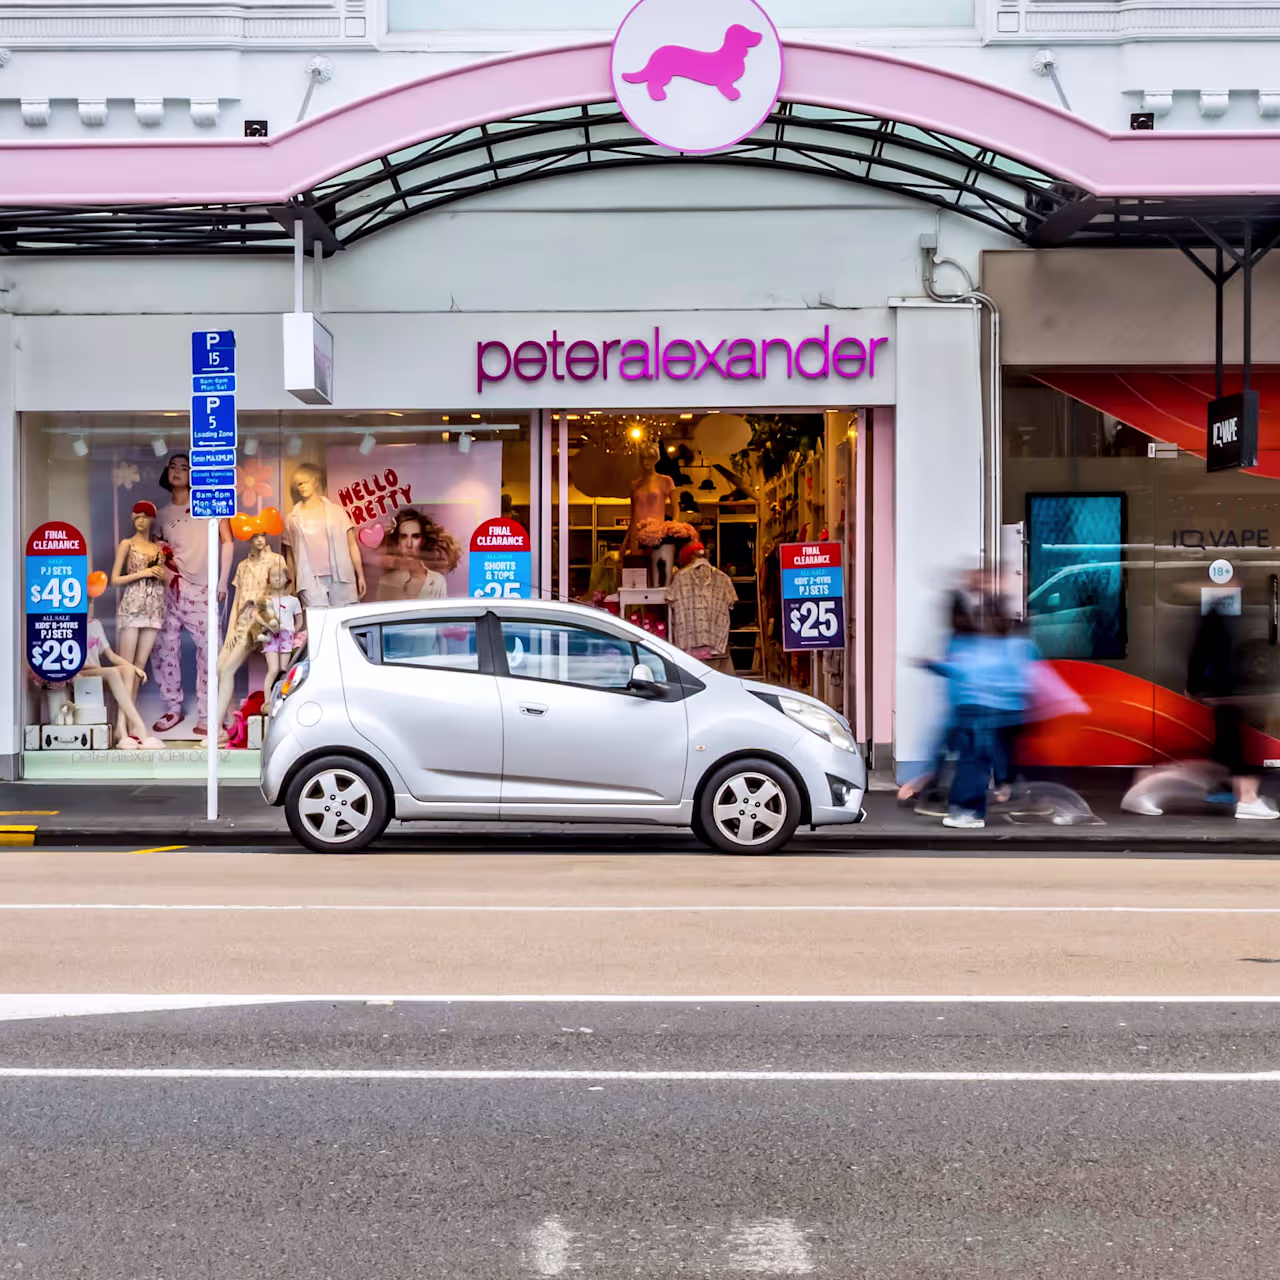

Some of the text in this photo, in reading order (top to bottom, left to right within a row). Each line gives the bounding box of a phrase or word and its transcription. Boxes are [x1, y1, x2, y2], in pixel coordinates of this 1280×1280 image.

[206, 332, 220, 350] P
[208, 352, 220, 365] 15
[477, 324, 888, 394] peteralexander
[206, 397, 220, 414] P
[208, 415, 217, 429] 5
[194, 431, 217, 439] Loading
[205, 453, 234, 462] MAXIMUM
[337, 468, 399, 508] HELLO
[45, 530, 68, 539] FINAL
[489, 526, 512, 535] FINAL
[33, 540, 80, 550] CLEARANCE
[477, 536, 524, 546] CLEARANCE
[802, 546, 820, 555] FINAL
[793, 555, 830, 565] CLEARANCE
[52, 566, 72, 575] SETS
[484, 561, 516, 570] SHORTS
[494, 571, 515, 580] TOPS
[1212, 567, 1231, 577] 18+
[30, 577, 82, 608] $49
[810, 585, 829, 595] SETS
[790, 601, 838, 637] $25
[52, 629, 73, 639] SETS
[31, 639, 82, 671] $29
[70, 749, 232, 765] peteralexander.conz
